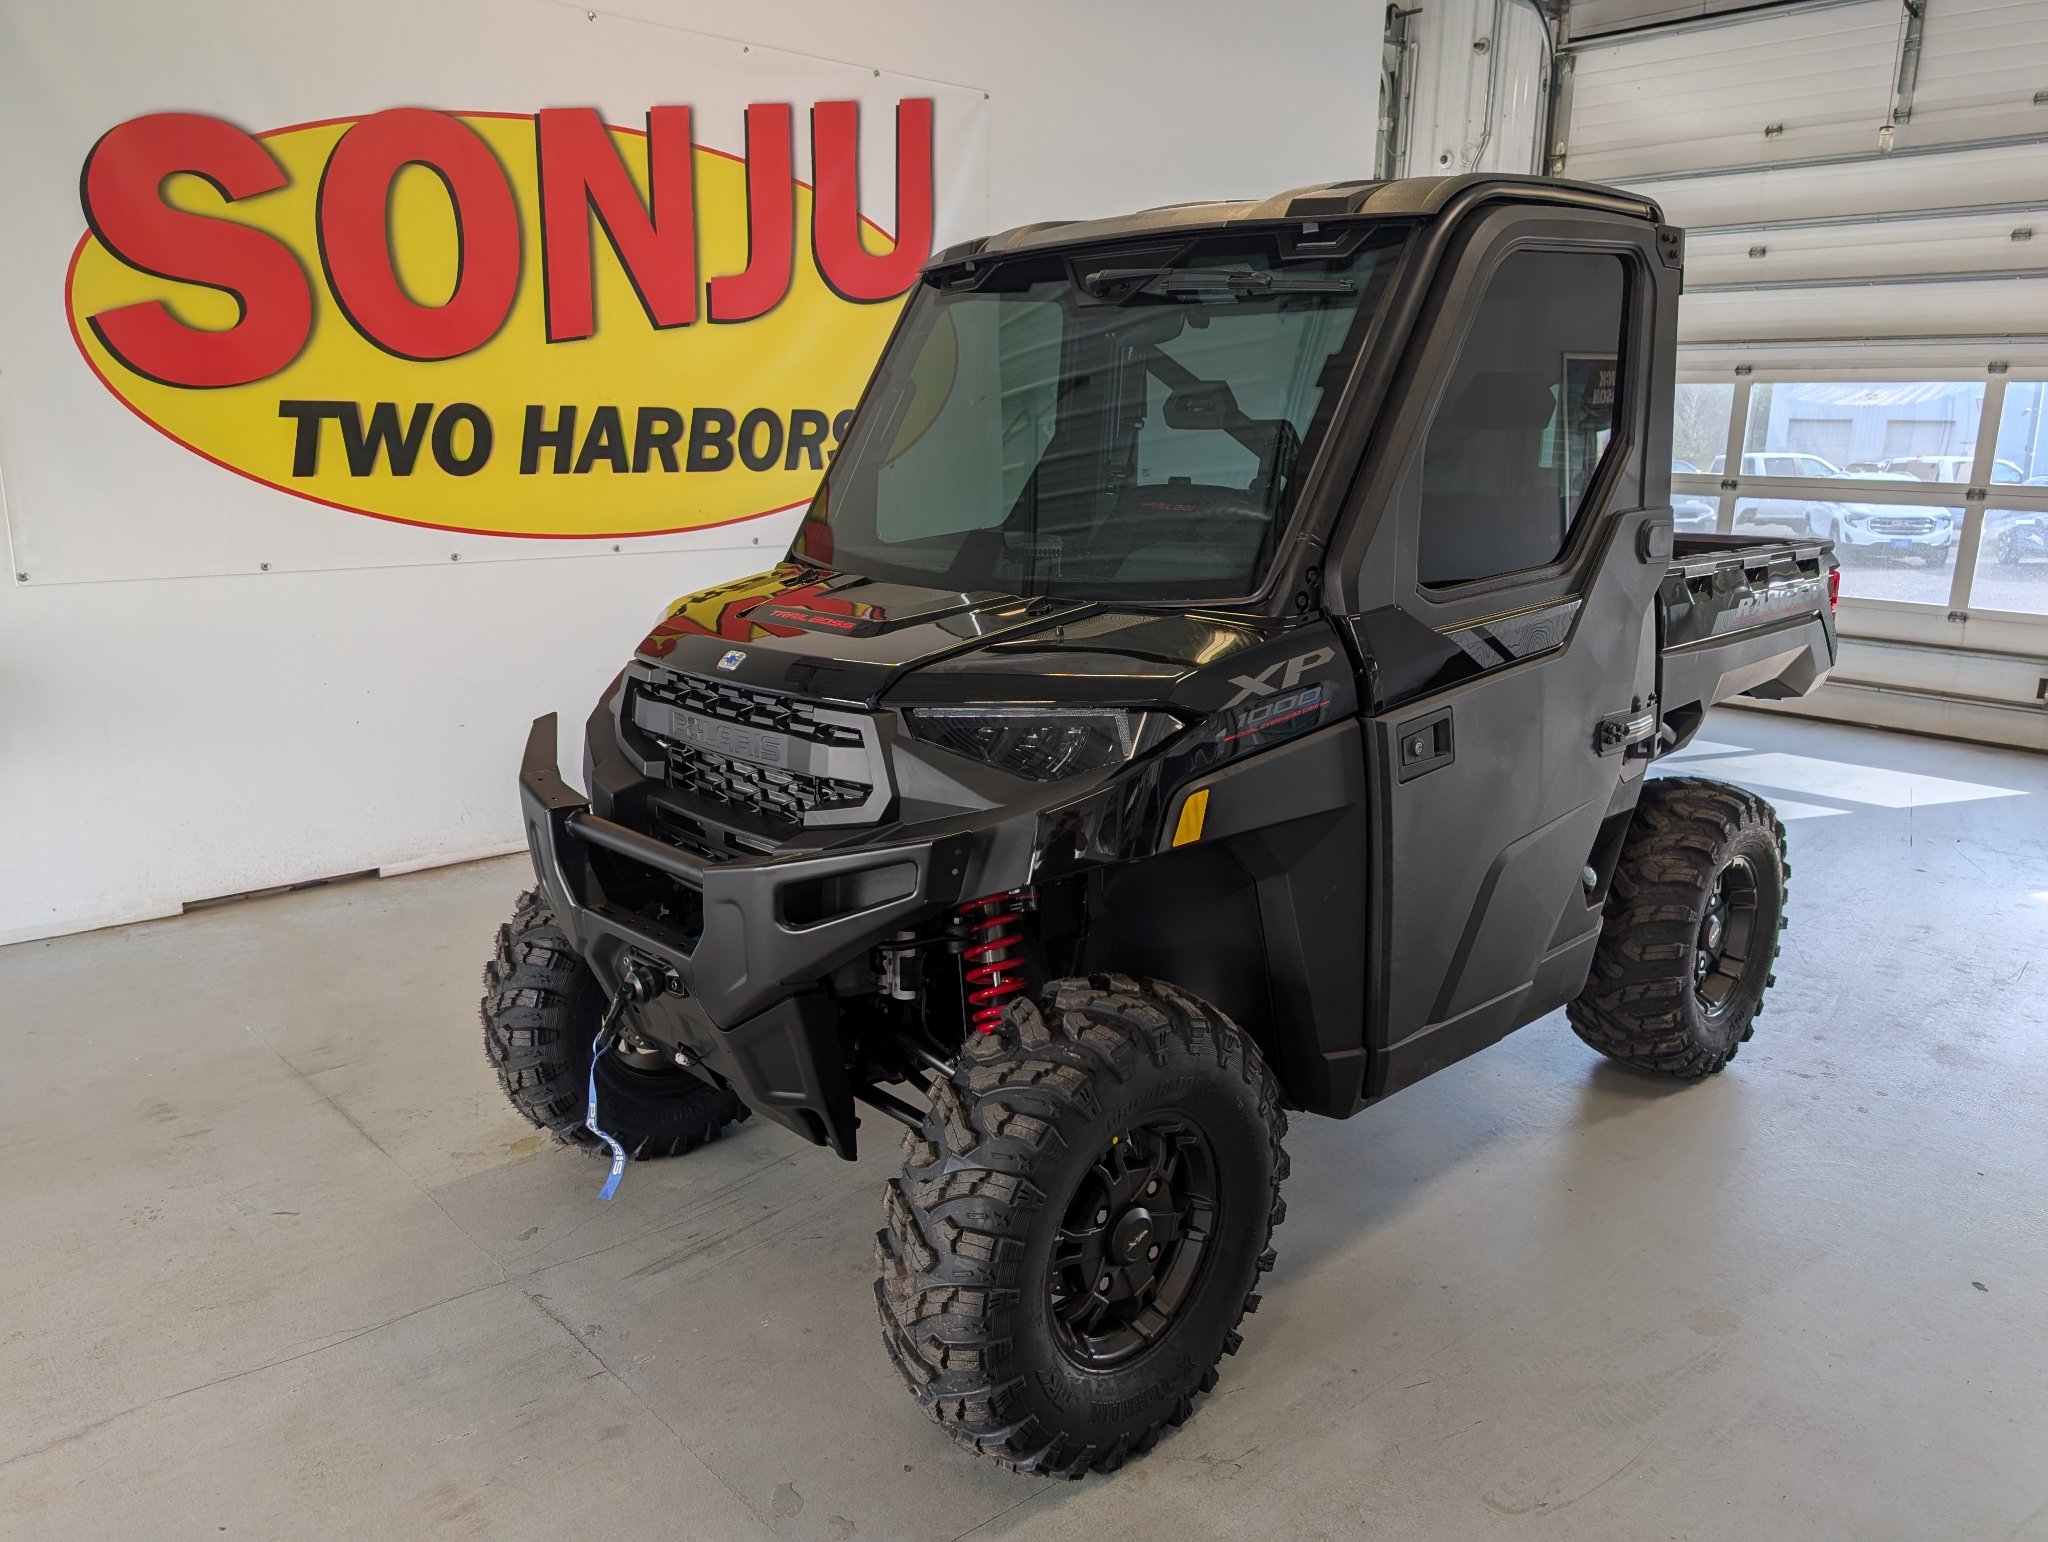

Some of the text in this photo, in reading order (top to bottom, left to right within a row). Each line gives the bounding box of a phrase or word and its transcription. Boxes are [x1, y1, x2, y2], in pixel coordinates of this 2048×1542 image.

[79, 97, 933, 389] SONJU
[277, 399, 493, 478] TWO
[768, 609, 857, 629] TRAIL BOSS
[1222, 646, 1336, 710] XP
[672, 710, 782, 763] POLARIS
[1237, 686, 1323, 729] 1000
